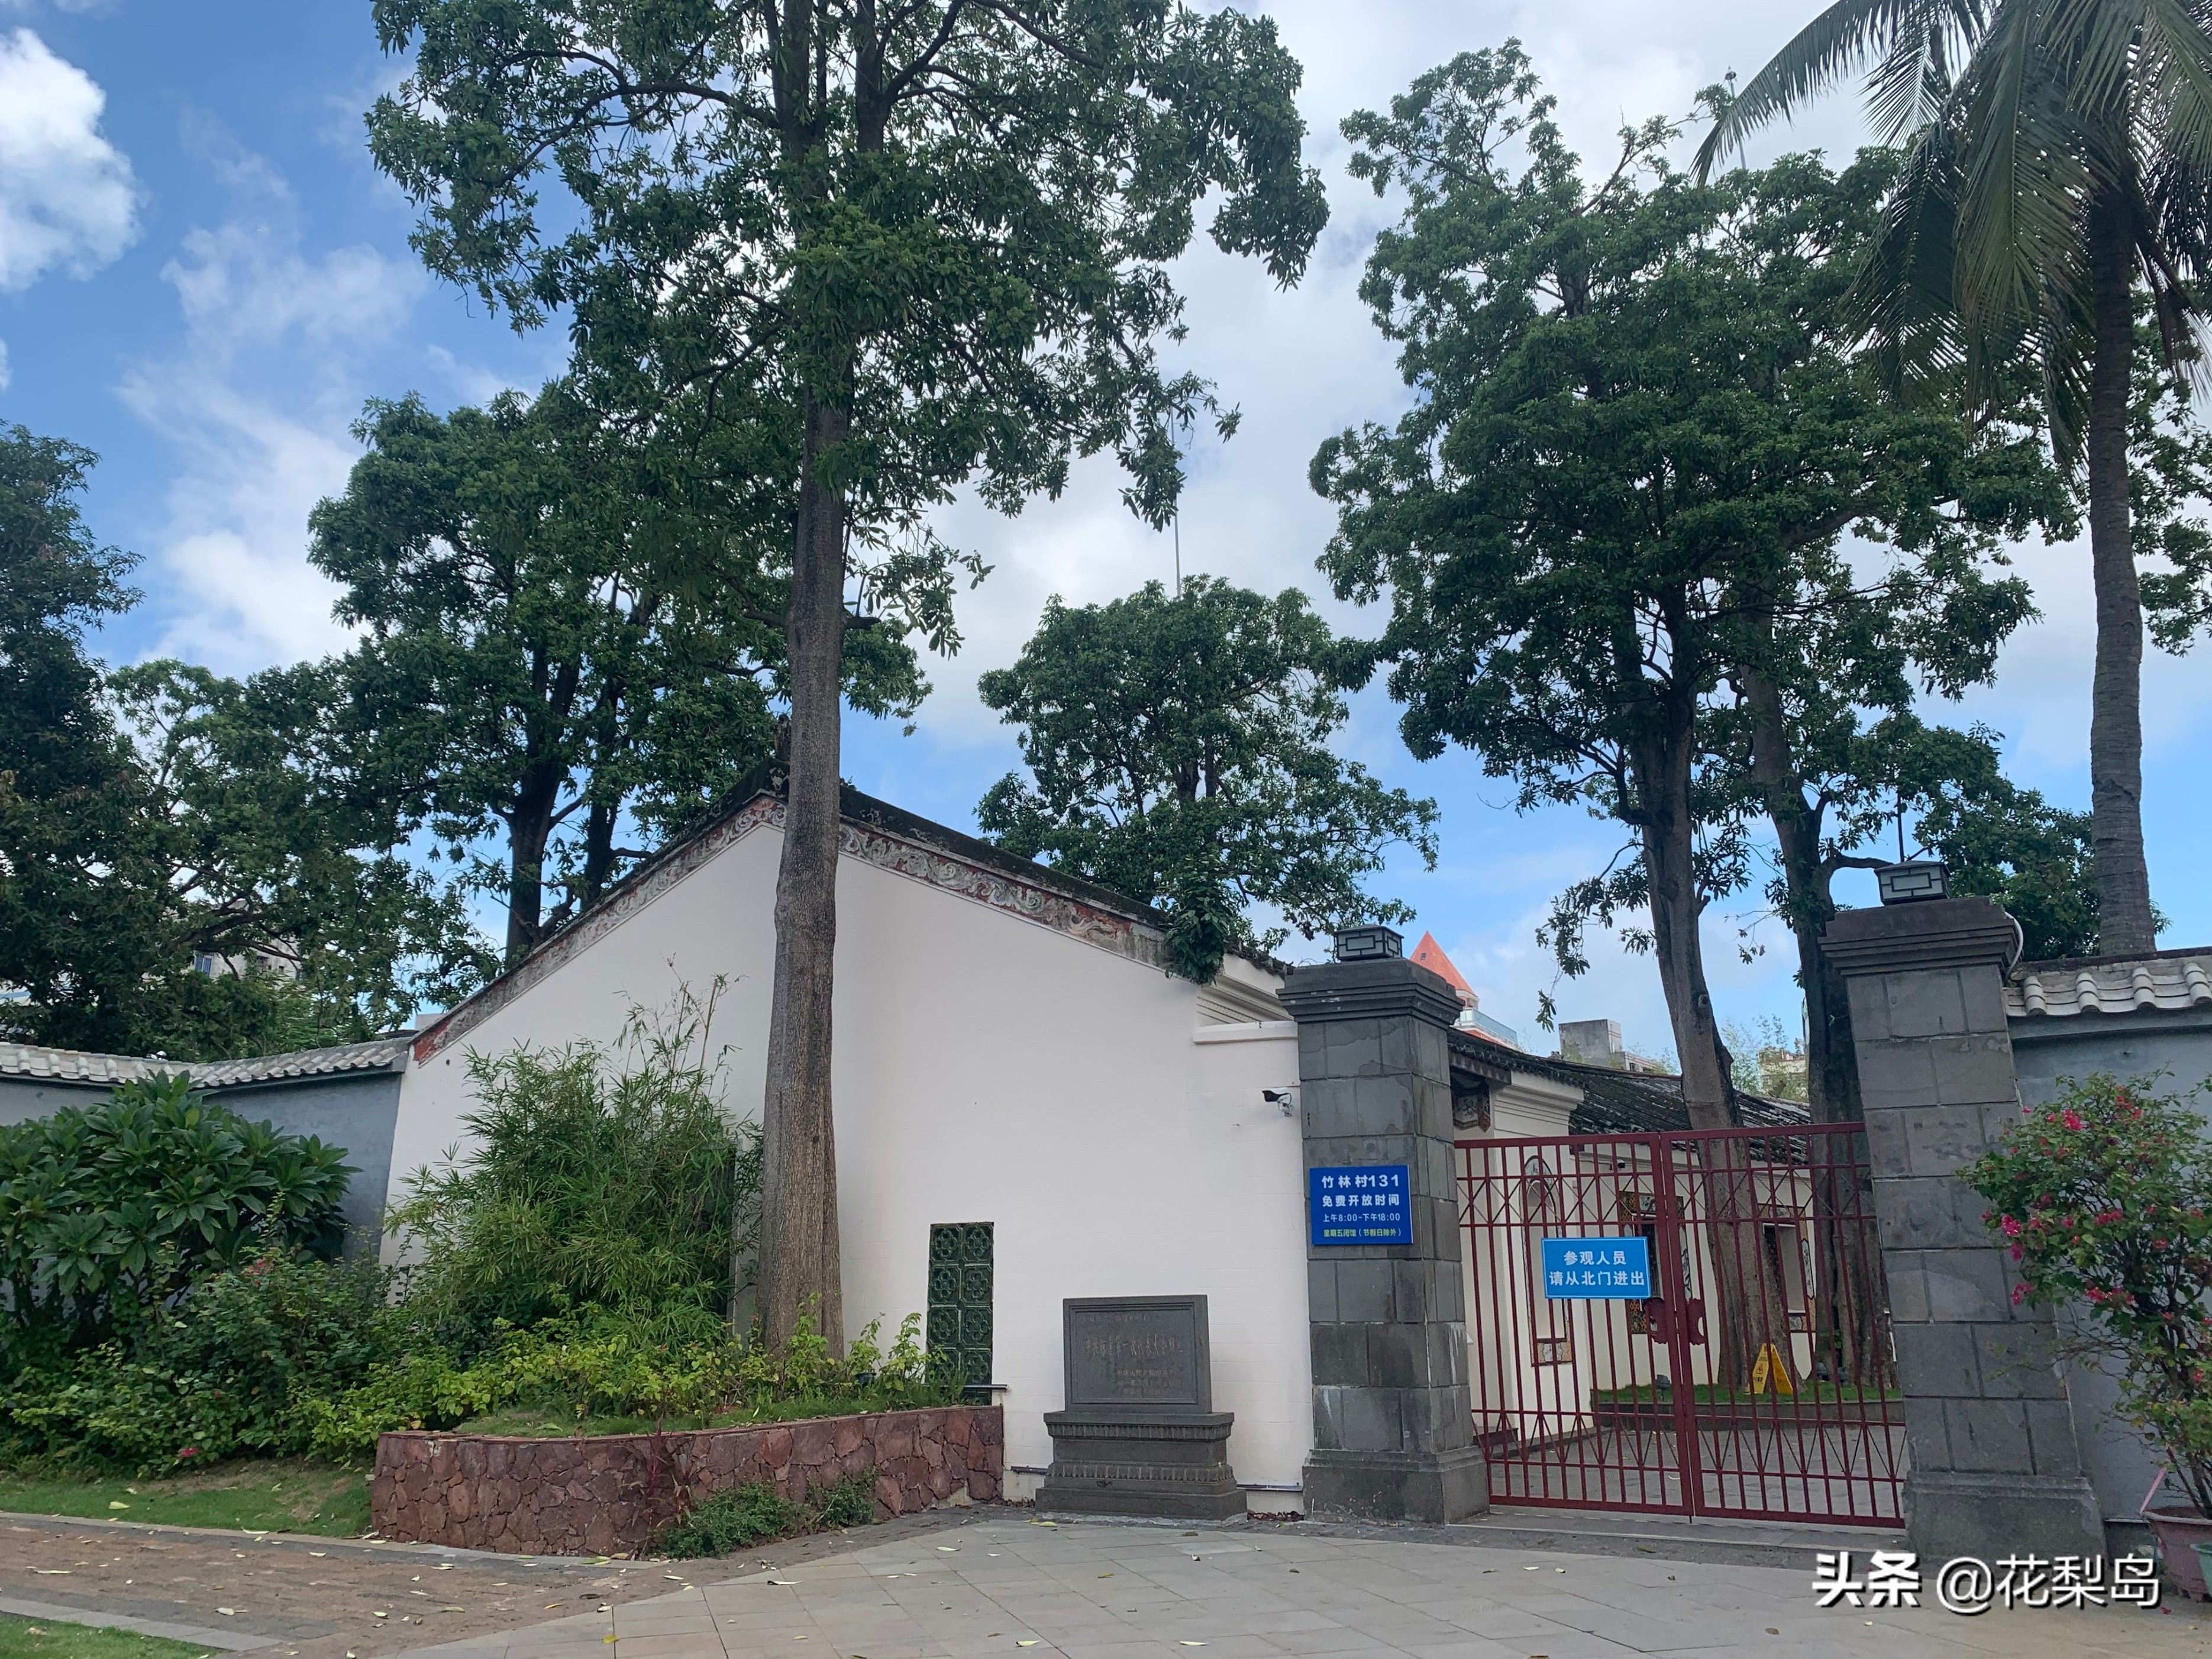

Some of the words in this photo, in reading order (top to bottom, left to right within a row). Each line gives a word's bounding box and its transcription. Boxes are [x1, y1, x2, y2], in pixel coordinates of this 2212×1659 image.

[1321, 1174, 1399, 1189] 竹林村131
[1322, 1194, 1400, 1208] 免费开放时间
[1564, 1250, 1626, 1266] 参观人员
[1549, 1270, 1645, 1286] 请从北门进出
